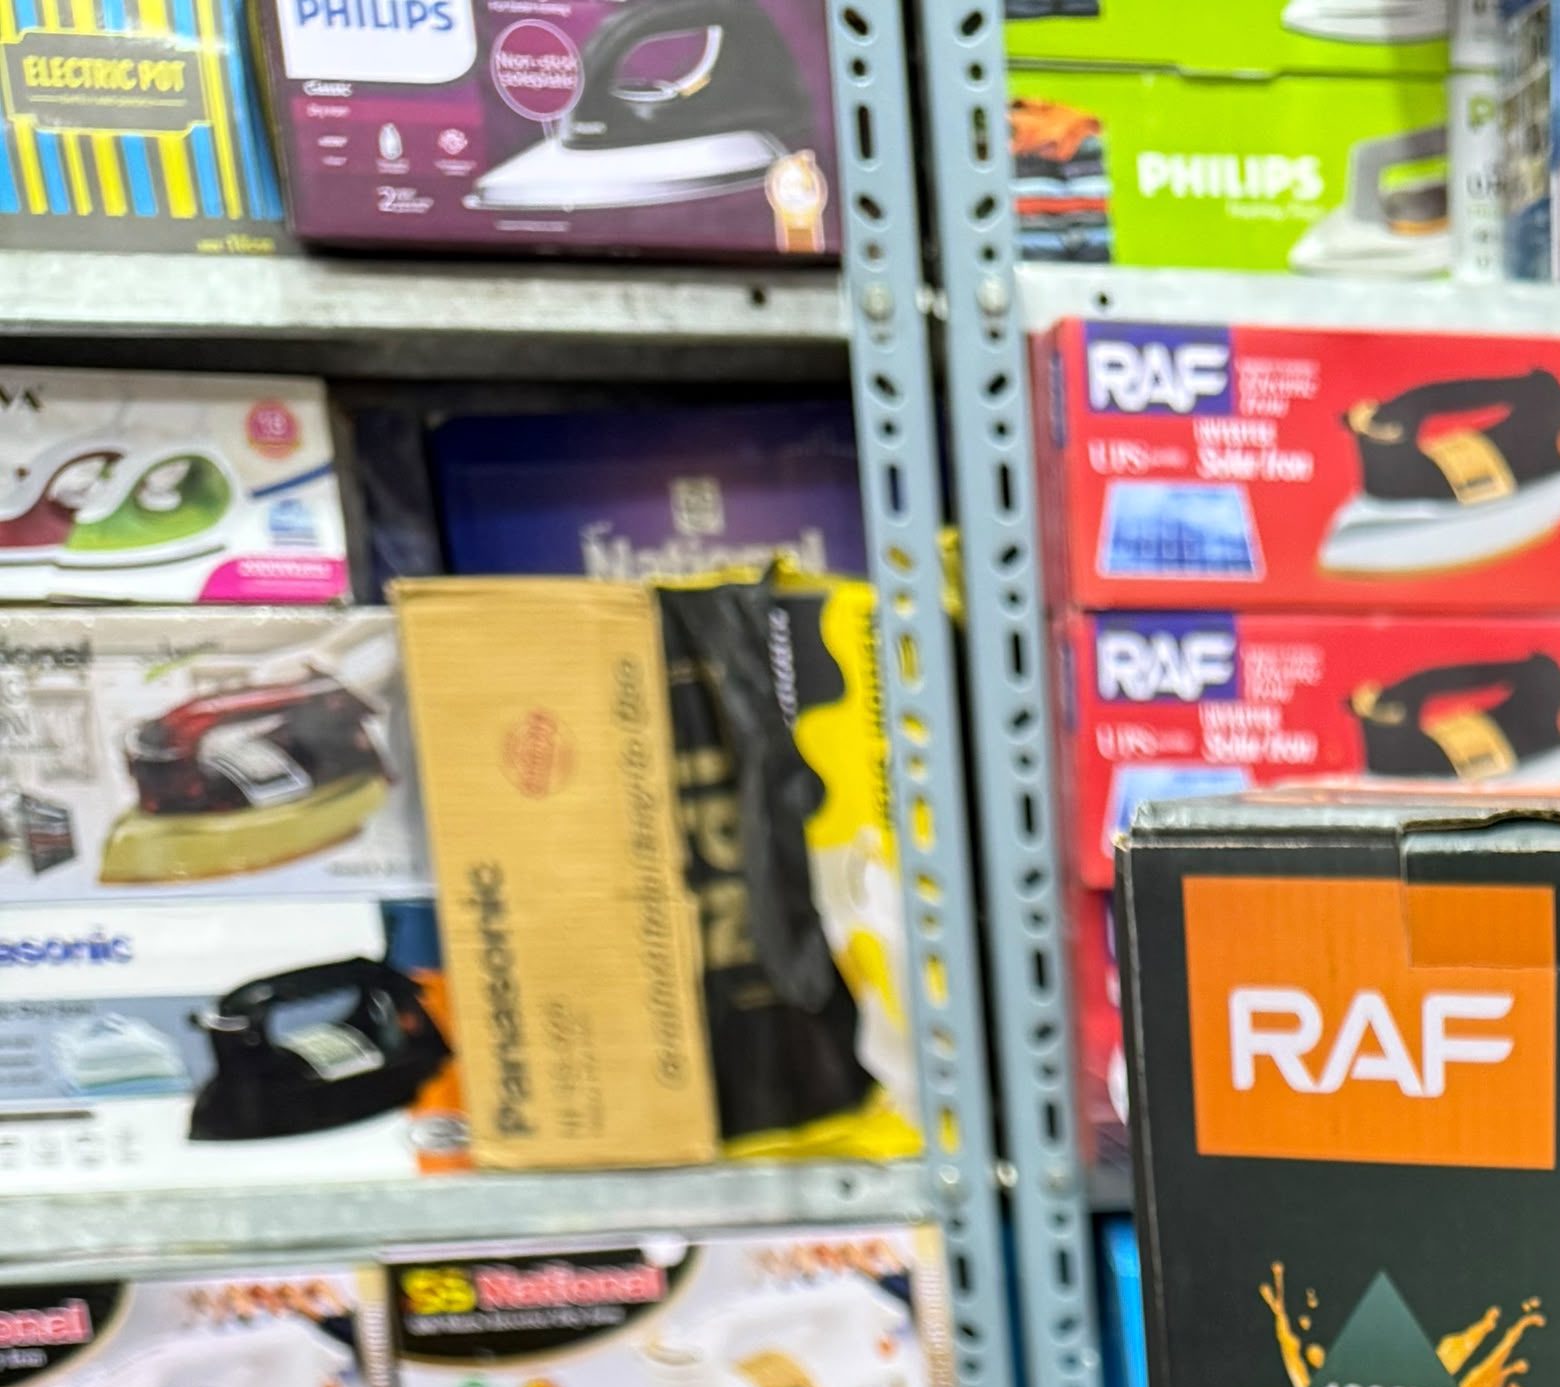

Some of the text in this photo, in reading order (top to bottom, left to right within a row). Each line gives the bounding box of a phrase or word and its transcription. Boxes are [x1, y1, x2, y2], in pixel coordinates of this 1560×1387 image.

[299, 0, 454, 31] PHILIPS
[23, 55, 186, 93] ELECTRIC POT
[1137, 151, 1324, 200] PHILIPS
[1089, 341, 1229, 412] RAF
[1099, 633, 1237, 701] RAF
[469, 860, 537, 1138] Panasonic
[1229, 986, 1515, 1099] RAF
[474, 1260, 668, 1312] National
